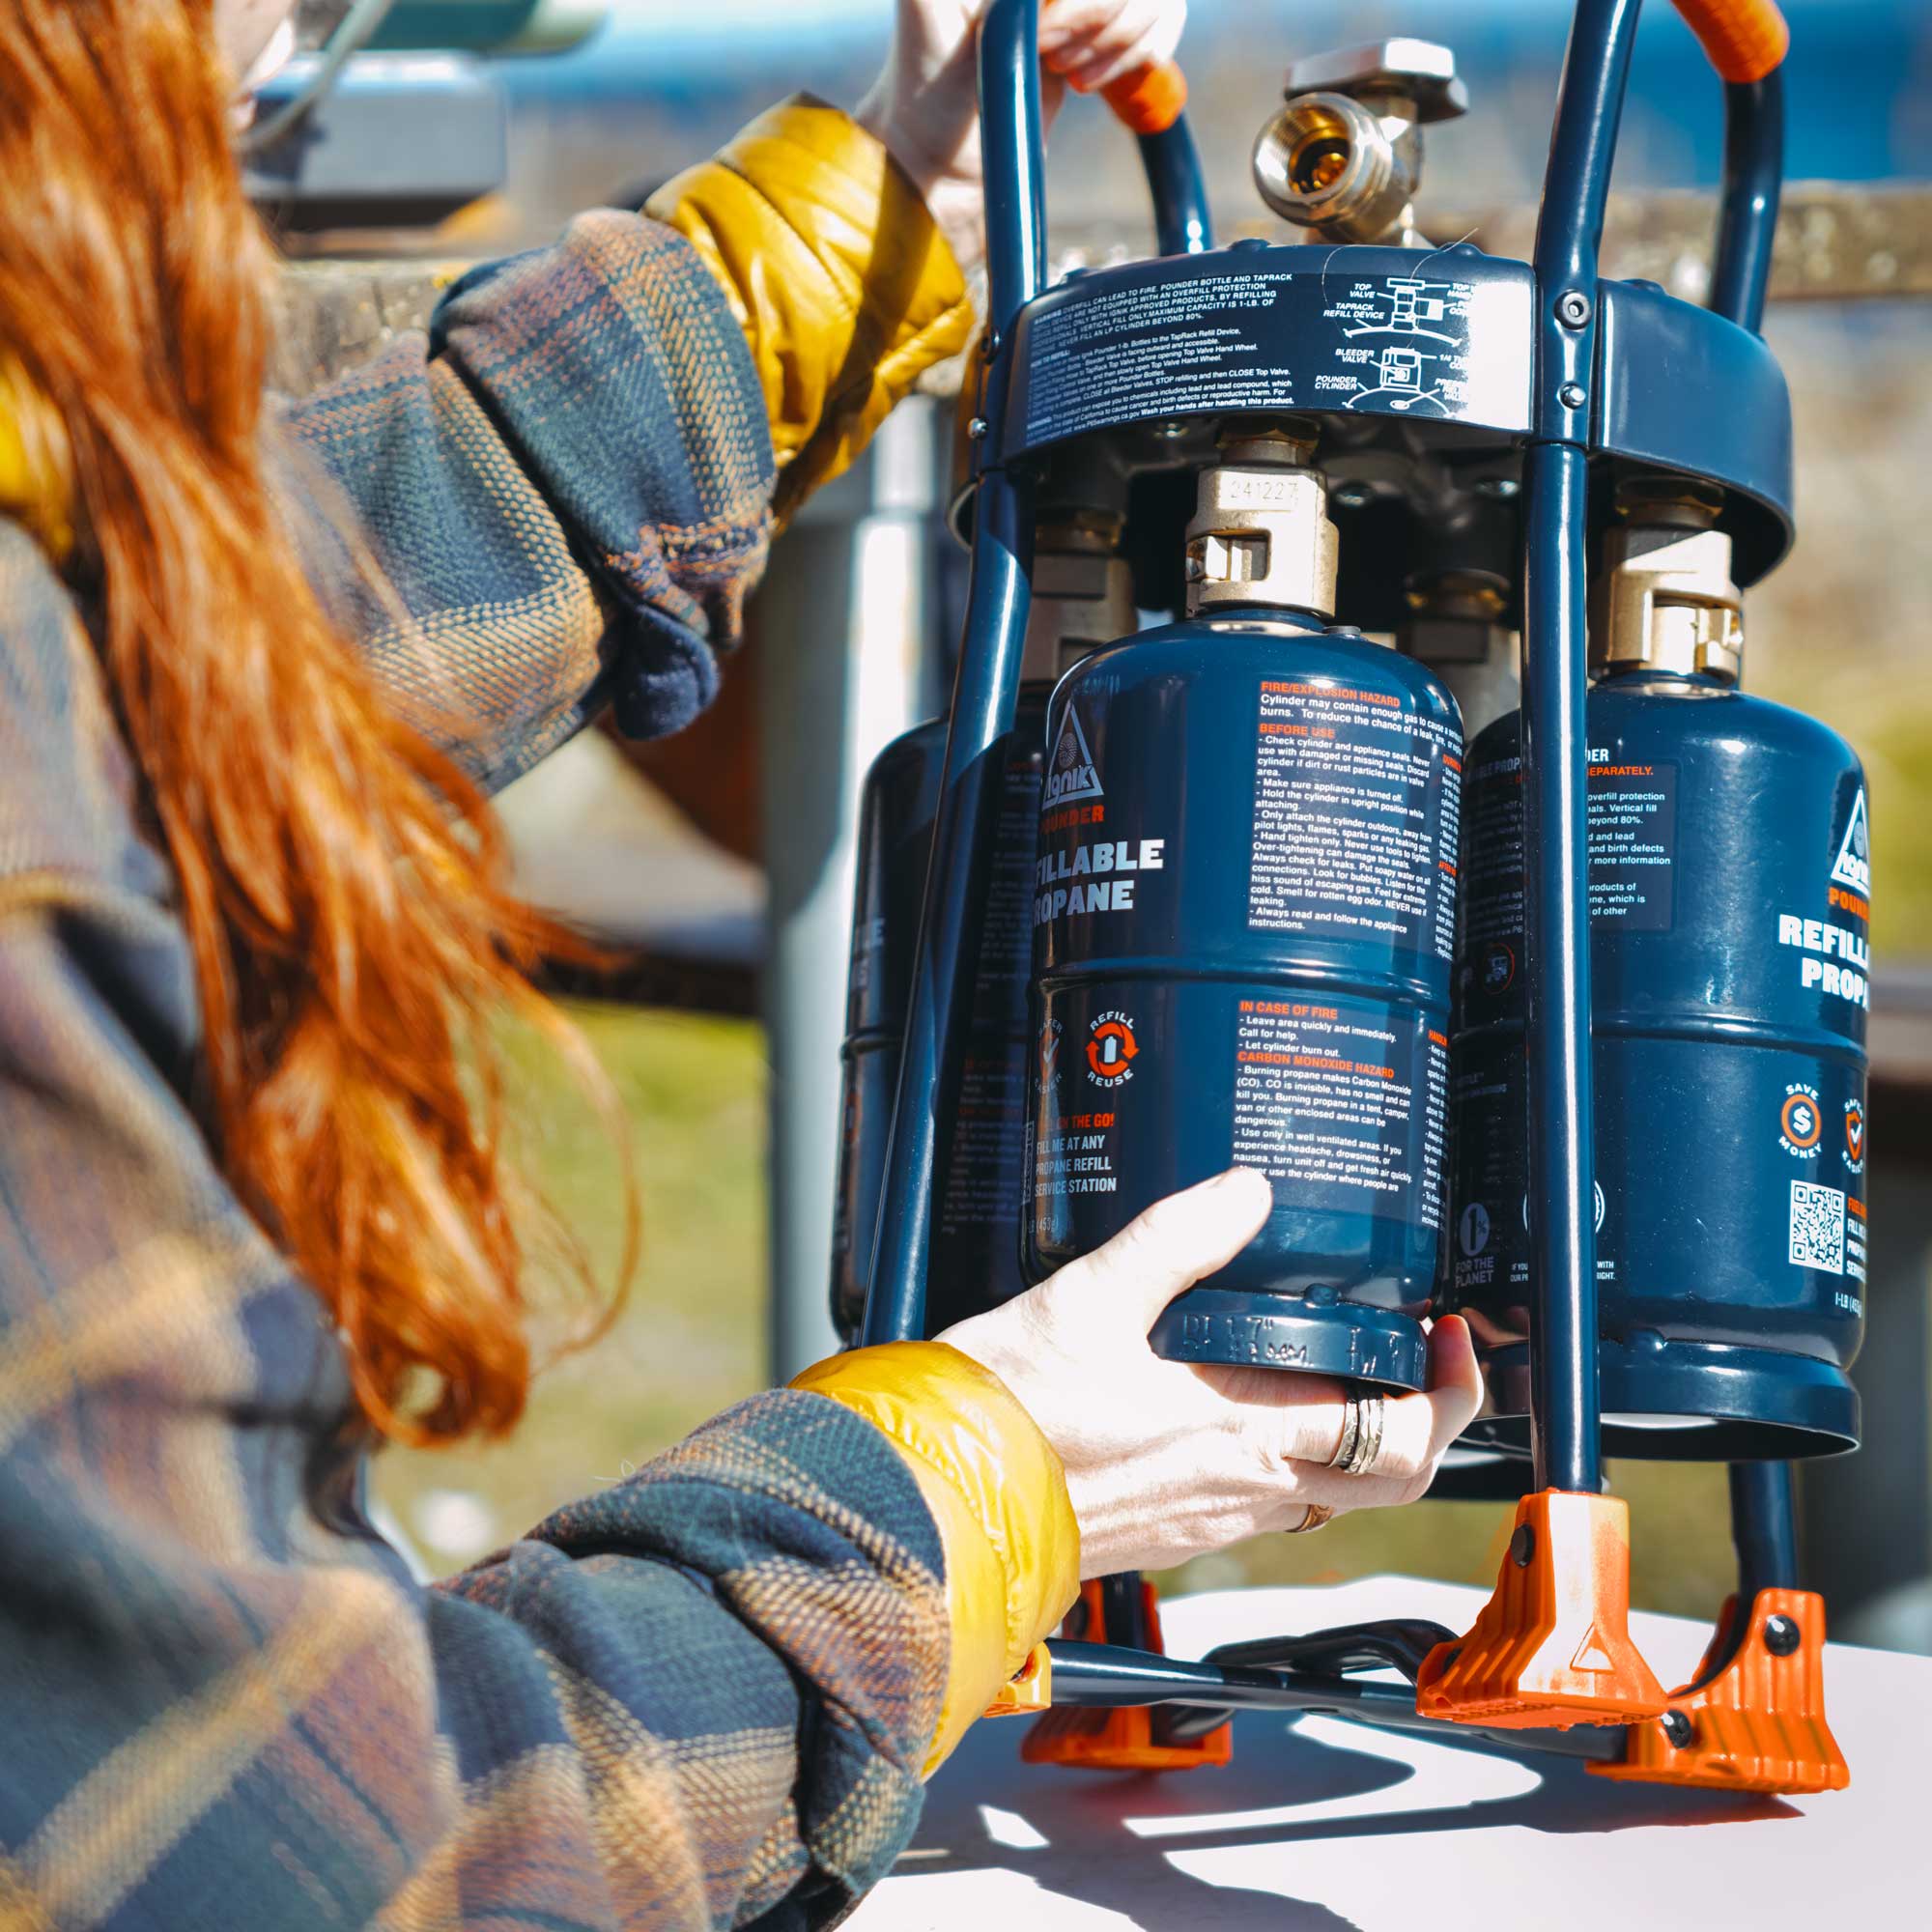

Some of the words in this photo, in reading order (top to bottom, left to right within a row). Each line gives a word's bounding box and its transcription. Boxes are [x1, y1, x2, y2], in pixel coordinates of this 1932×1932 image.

[1160, 280, 1198, 291] POUNDER
[1201, 277, 1232, 286] BOTTLE
[1173, 287, 1209, 297] OVERFILL
[1212, 283, 1265, 292] PROTECTION
[1129, 300, 1169, 312] APPROVED
[1186, 302, 1225, 311] CAPACITY
[1335, 302, 1374, 311] TAPRACK
[1323, 309, 1351, 318] REFILL
[1353, 310, 1385, 320] DEVICE
[1335, 348, 1375, 357] BLEEDER
[1342, 355, 1369, 363] VALVE
[1315, 382, 1357, 390] CYLINDER
[1316, 375, 1357, 384] POUNDER
[1261, 682, 1357, 699] FIRE/EXPLOSION
[1359, 692, 1400, 707] HAZARD
[1261, 694, 1305, 706] Cylinder
[1309, 700, 1330, 711] may
[1333, 702, 1368, 713] contain
[1372, 708, 1402, 722] enough
[1405, 715, 1417, 724] gas
[1419, 717, 1426, 726] to
[1259, 724, 1307, 735] BEFORE
[1312, 727, 1335, 738] USE
[1265, 735, 1294, 744] Check
[1296, 738, 1332, 748] cylinder
[1352, 746, 1390, 756] appliance
[1412, 755, 1430, 767] Never
[1299, 749, 1340, 760] damaged
[1353, 755, 1383, 768] missing
[1406, 765, 1429, 778] Discard
[1619, 792, 1665, 803] protection
[1609, 804, 1643, 812] Vertical
[1645, 804, 1658, 812] fill
[1044, 805, 1104, 835] OUNDER
[1620, 815, 1644, 825] 80%.
[1589, 844, 1605, 853] and
[1607, 844, 1629, 853] birth
[1631, 844, 1664, 853] defects
[1619, 856, 1671, 865] information
[1608, 895, 1634, 903] which
[1637, 895, 1645, 903] is
[1592, 907, 1602, 916] of
[1603, 906, 1627, 915] other
[1257, 907, 1289, 918] Always
[1333, 913, 1357, 923] follow
[1360, 917, 1372, 925] the
[1375, 921, 1406, 932] appliance
[1778, 914, 1869, 971] REFILL
[1239, 1001, 1252, 1011] IN
[1256, 1003, 1290, 1014] CASE
[1293, 1006, 1308, 1016] OF
[1312, 1008, 1337, 1019] FIRE
[1090, 1010, 1134, 1031] REFILL
[1239, 1028, 1258, 1037] Call
[1276, 1031, 1298, 1041] help.
[1246, 1016, 1275, 1025] Leave
[1301, 1021, 1331, 1033] quickly
[1351, 1027, 1396, 1042] immediately.
[1263, 1043, 1298, 1052] cylinder
[1302, 1046, 1321, 1055] burn
[1237, 1052, 1290, 1064] CARBON
[1293, 1056, 1352, 1070] MONOXIDE
[1355, 1064, 1394, 1078] HAZARD
[1088, 1067, 1134, 1088] REUSE
[1244, 1065, 1280, 1077] Burning
[1283, 1070, 1320, 1079] propane
[1322, 1074, 1350, 1083] makes
[1351, 1076, 1379, 1088] Carbon
[1381, 1082, 1411, 1094] Monoxide
[1785, 1082, 1819, 1101] SAVE
[1071, 1115, 1091, 1129] THE
[1093, 1112, 1115, 1128] GO!
[1793, 1105, 1812, 1135] $
[1037, 1141, 1050, 1155] FILL
[1052, 1138, 1065, 1152] ME
[1066, 1136, 1080, 1151] AT
[1081, 1134, 1106, 1150] ANY
[1777, 1135, 1823, 1160] MONEY
[1073, 1156, 1112, 1172] REFILL
[1035, 1180, 1066, 1198] SERVICE
[1068, 1177, 1117, 1194] STATION
[1474, 1256, 1494, 1270] THE
